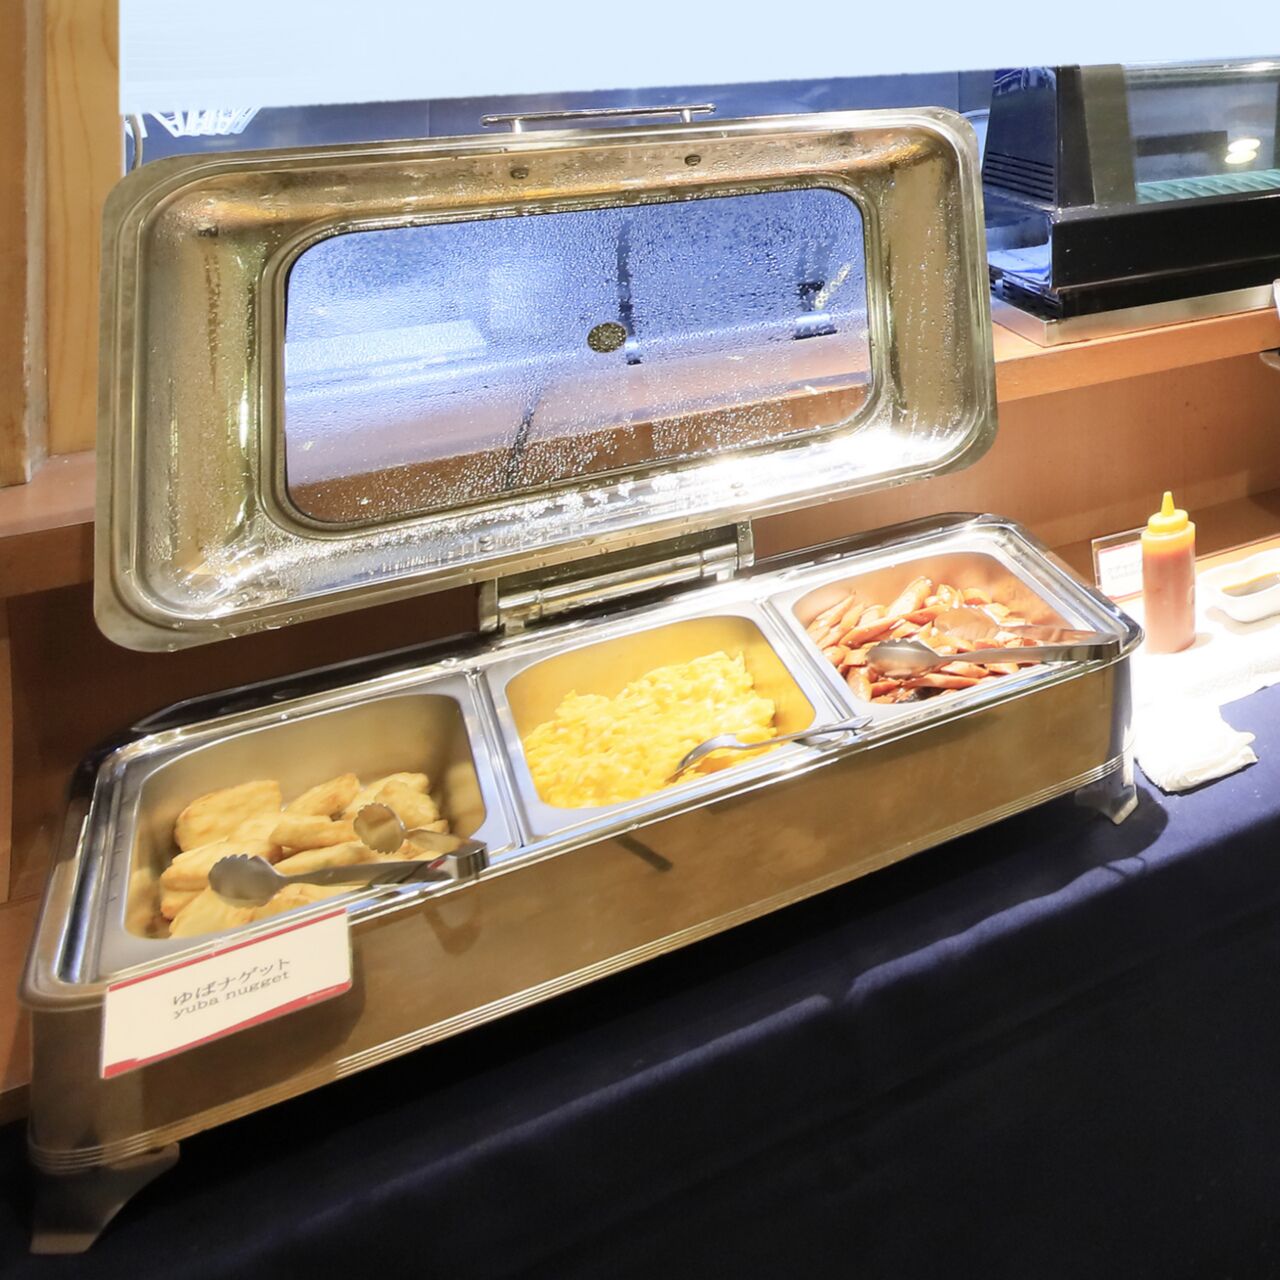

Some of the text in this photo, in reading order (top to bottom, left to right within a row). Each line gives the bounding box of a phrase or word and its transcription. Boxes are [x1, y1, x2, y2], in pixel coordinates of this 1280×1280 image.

[173, 959, 290, 1006] ゆばナゲット
[174, 971, 289, 1020] yuba nugget
